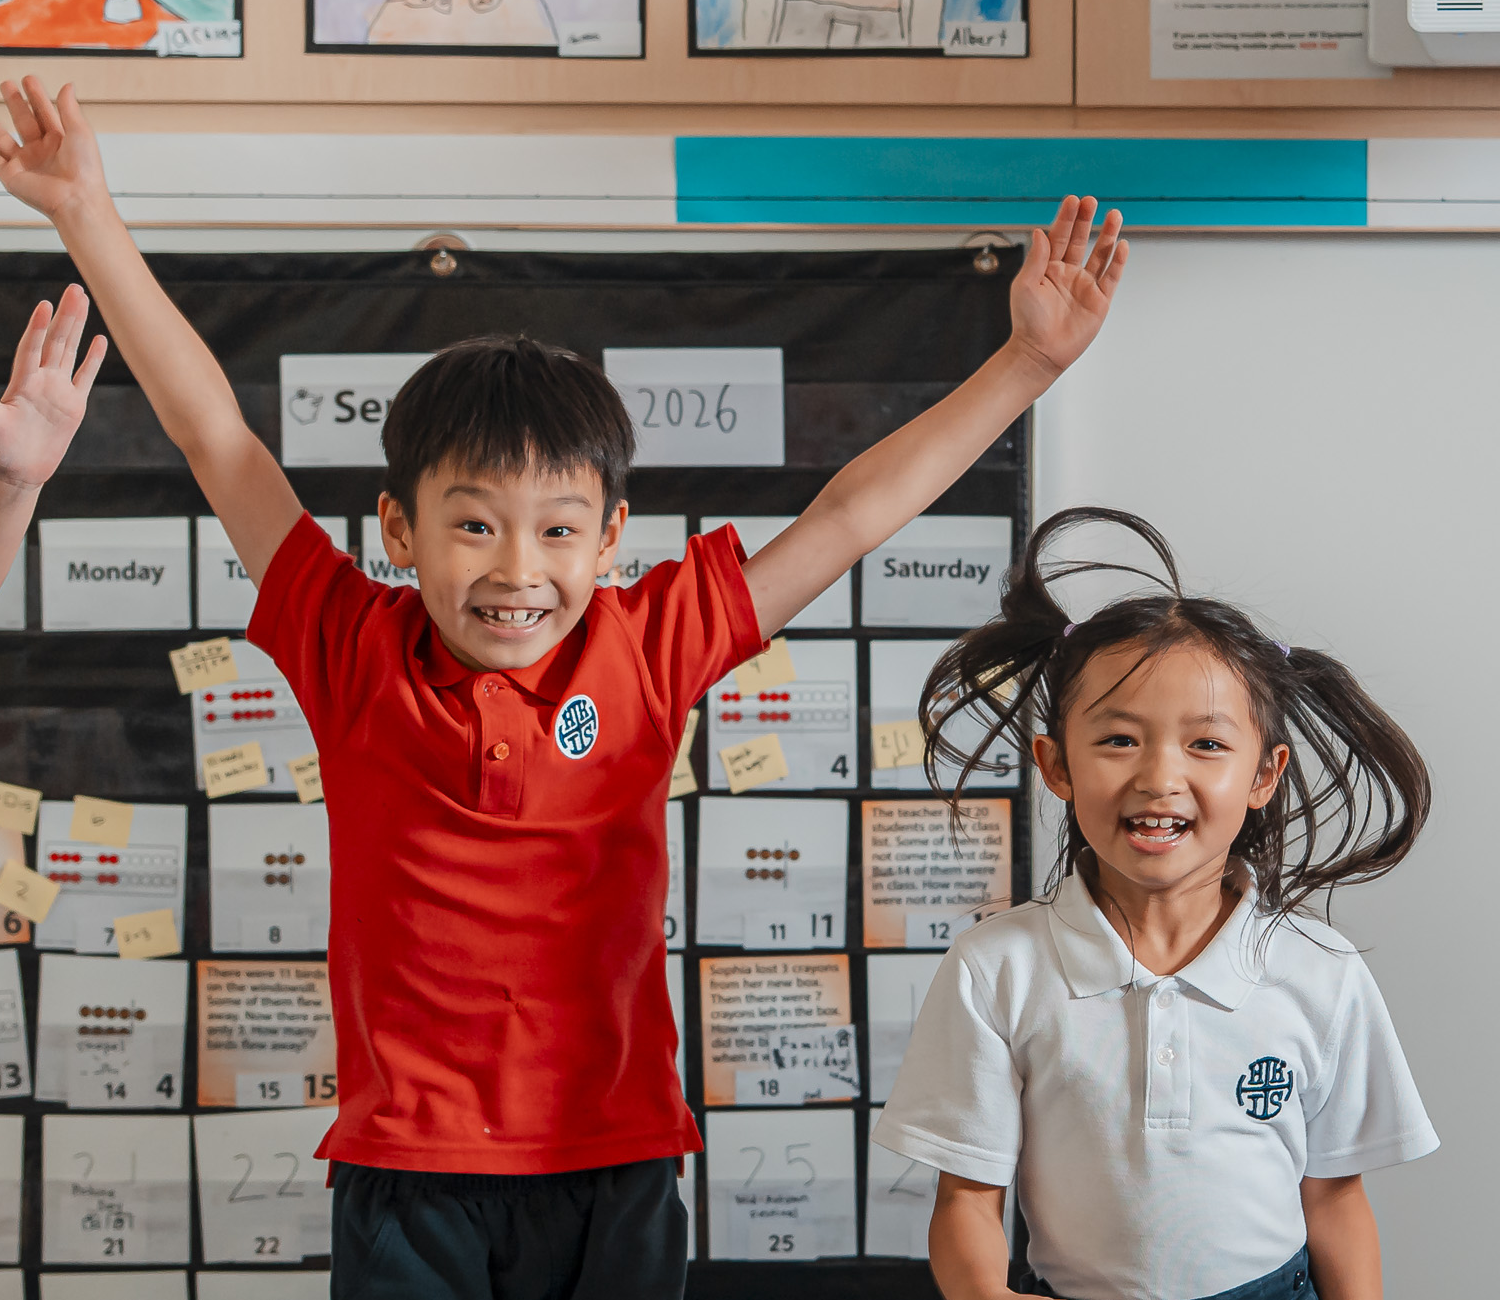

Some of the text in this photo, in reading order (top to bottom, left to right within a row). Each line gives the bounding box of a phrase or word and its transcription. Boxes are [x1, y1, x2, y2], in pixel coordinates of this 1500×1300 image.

[641, 383, 738, 433] 2026
[67, 557, 990, 588] Monday Saturday
[770, 923, 786, 940] 11
[929, 923, 949, 939] 12
[710, 963, 751, 976] Sophia
[792, 964, 839, 975] crayons
[259, 1074, 337, 1099] 15 15
[757, 1081, 779, 1096] 18
[103, 1238, 124, 1254] 21
